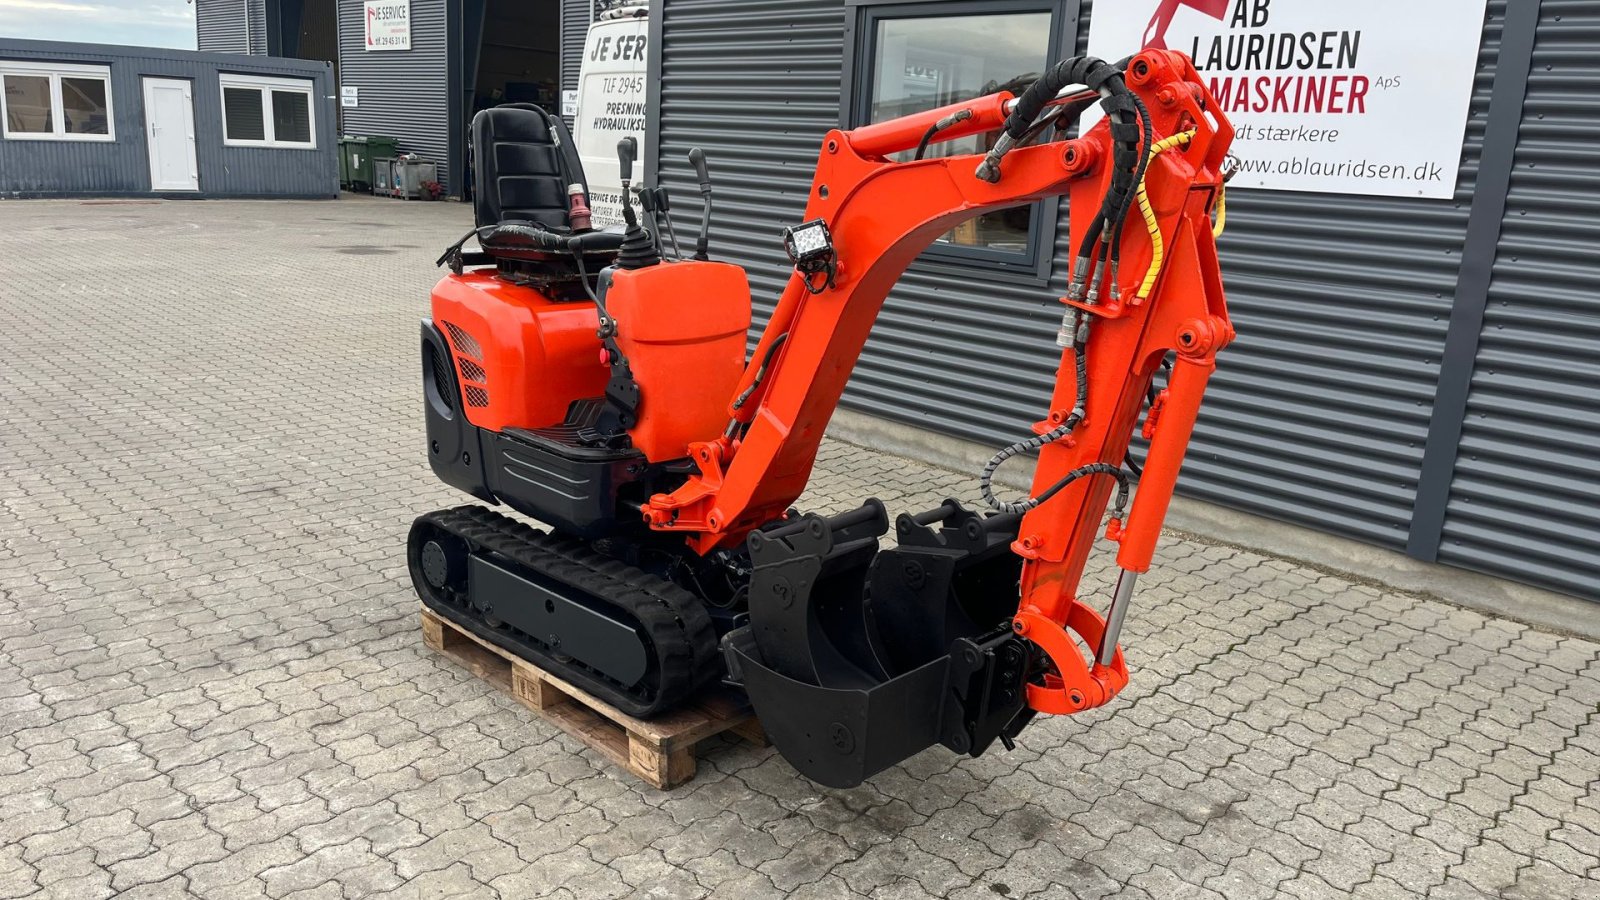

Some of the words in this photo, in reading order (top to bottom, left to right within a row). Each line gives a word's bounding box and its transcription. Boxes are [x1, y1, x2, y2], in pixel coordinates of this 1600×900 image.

[375, 7, 381, 20] JE
[382, 5, 406, 20] SERVICE
[1230, 0, 1271, 28] AB
[591, 36, 612, 61] JE
[613, 34, 647, 62] SER
[1190, 31, 1361, 71] LAURIDSEN
[603, 77, 617, 94] TLF
[618, 77, 643, 95] 2945
[1203, 75, 1369, 114] MASKINER
[1375, 75, 1401, 90] ApS
[1232, 123, 1254, 140] dt
[1257, 125, 1339, 143] stærkere
[1223, 156, 1443, 181] www.ablauridsen.dk
